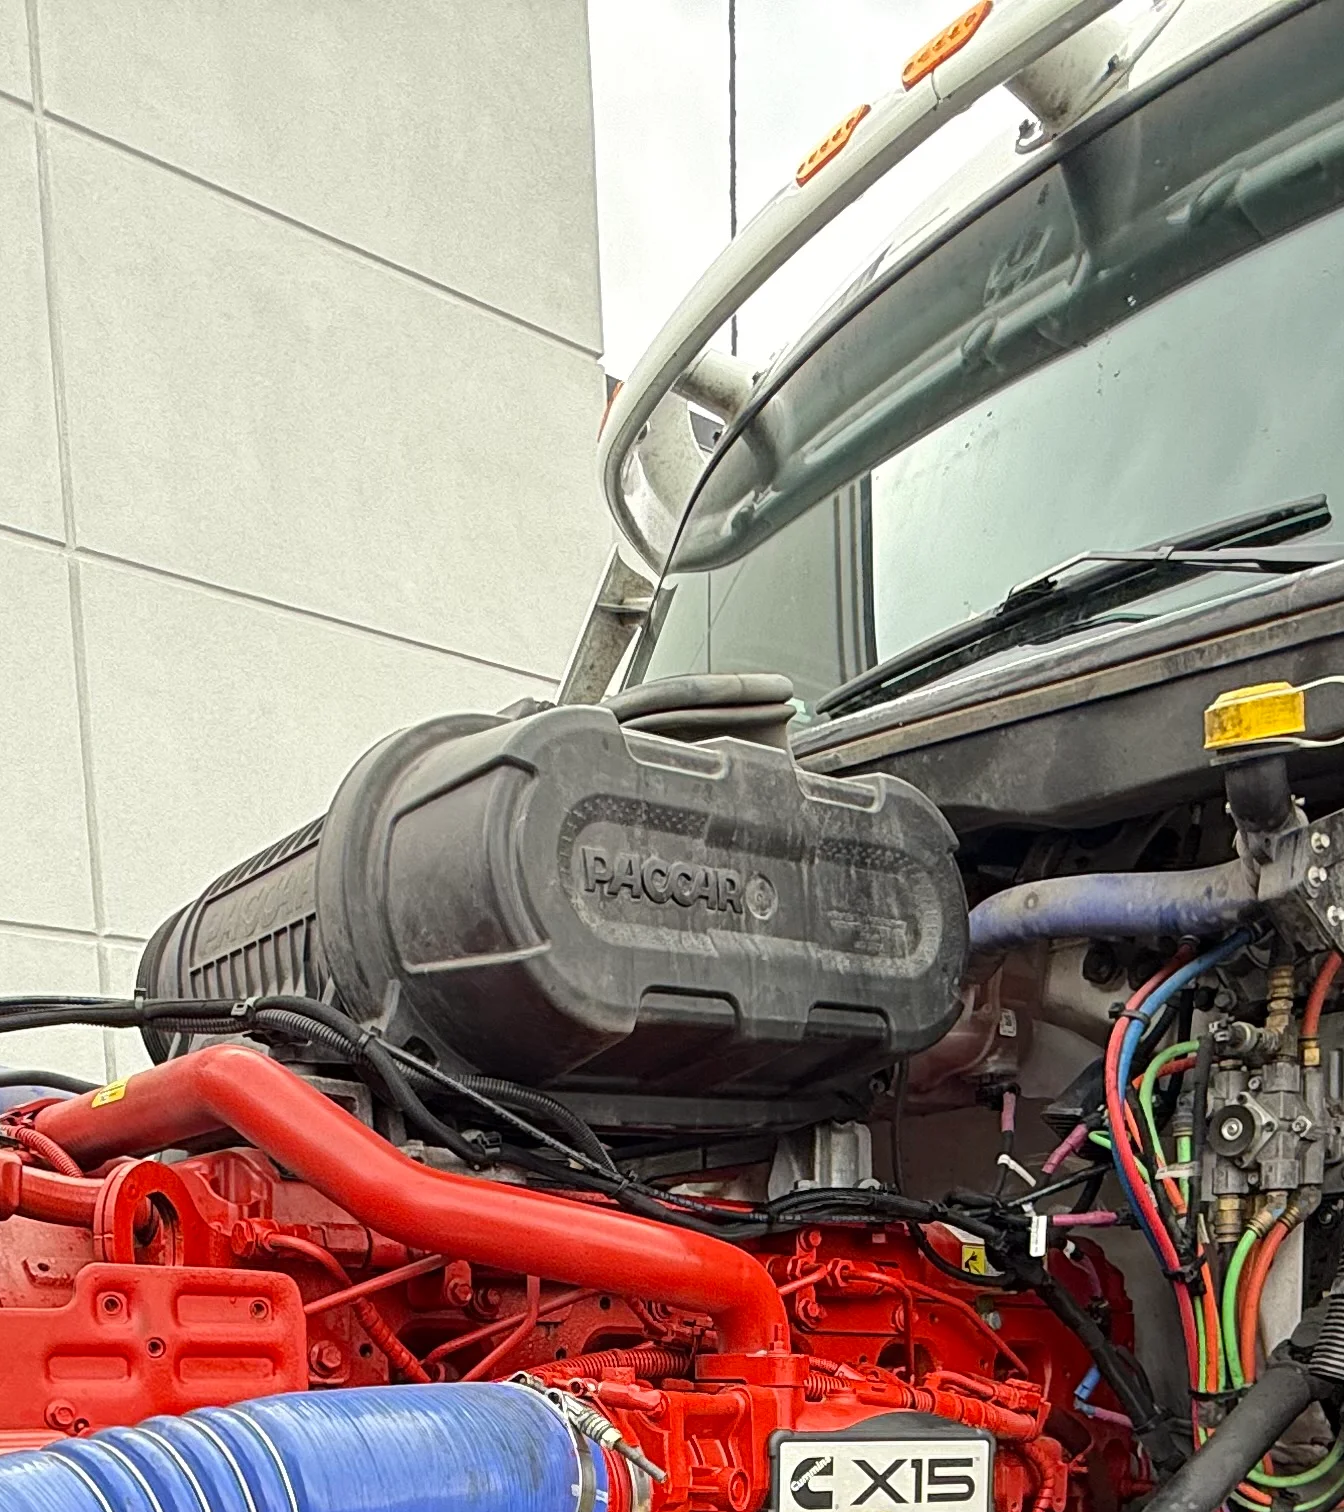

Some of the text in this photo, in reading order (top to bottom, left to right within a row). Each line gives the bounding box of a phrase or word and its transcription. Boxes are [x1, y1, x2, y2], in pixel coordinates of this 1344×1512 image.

[581, 845, 745, 914] PACCAR
[789, 1455, 976, 1506] Cummins X15
